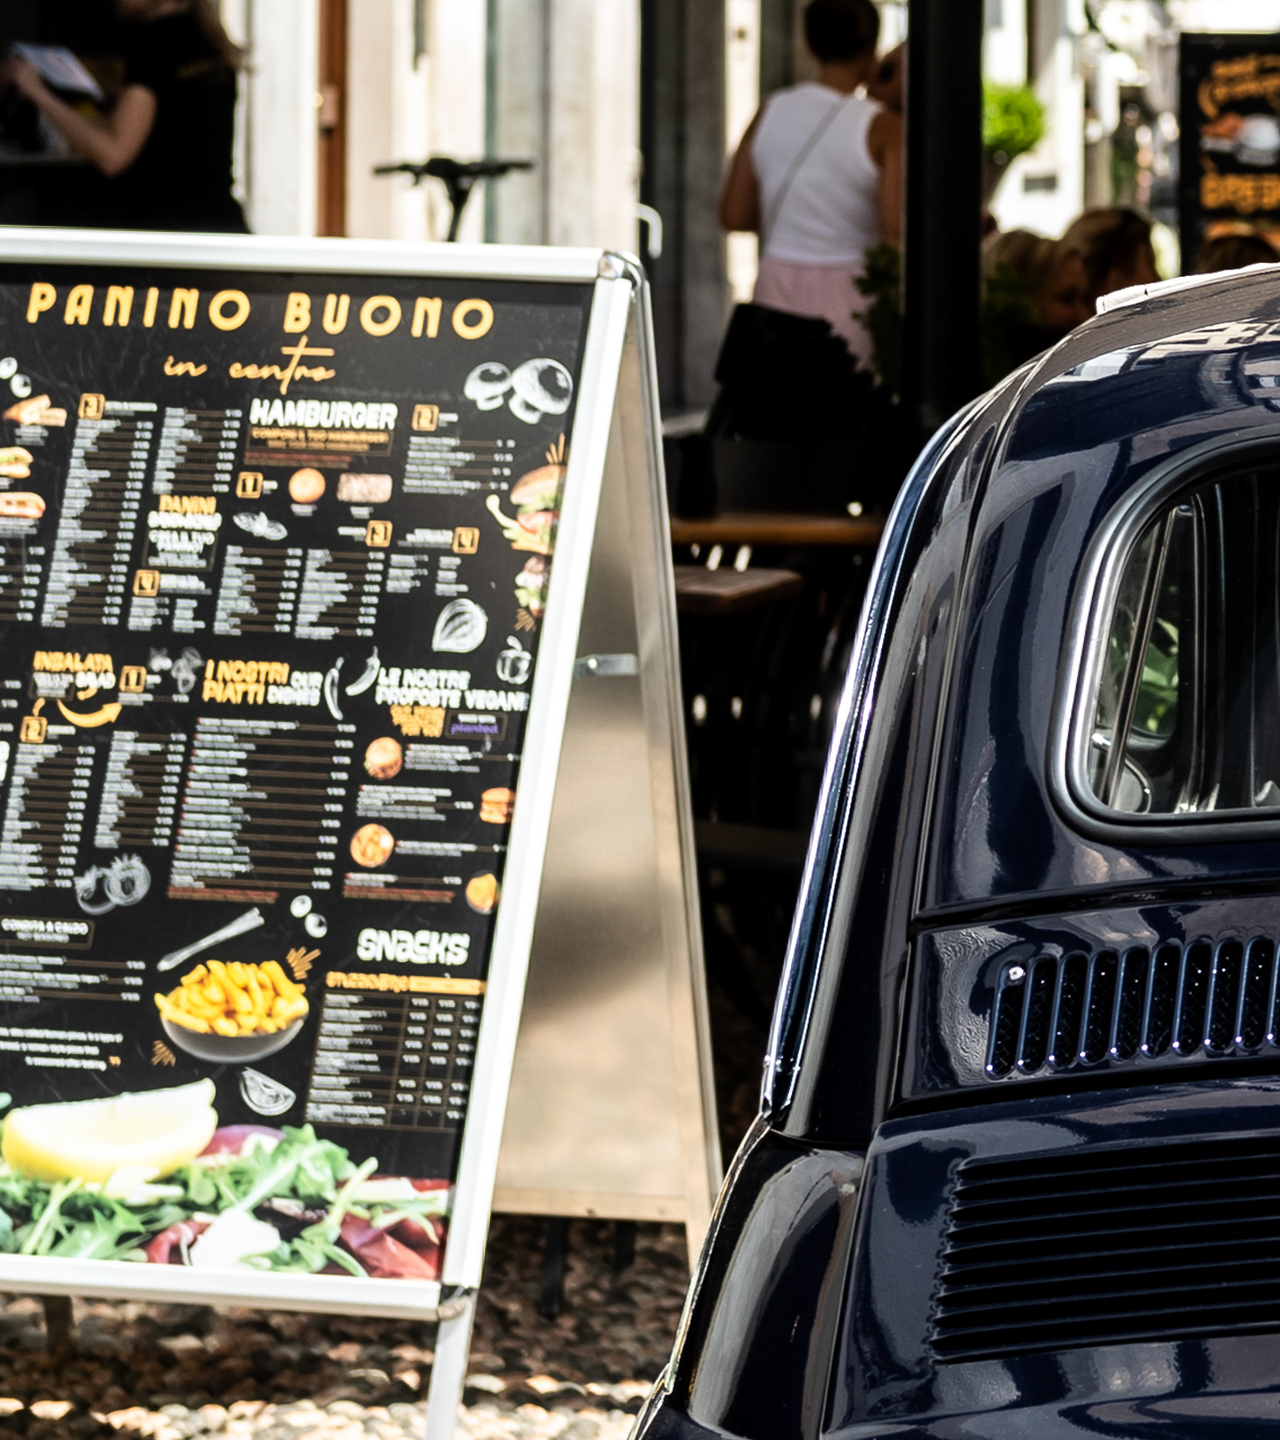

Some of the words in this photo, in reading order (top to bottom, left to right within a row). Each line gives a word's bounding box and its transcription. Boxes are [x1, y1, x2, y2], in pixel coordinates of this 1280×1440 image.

[26, 282, 250, 331] PANINO
[283, 292, 494, 340] BUONO
[163, 355, 207, 376] in
[229, 335, 335, 395] centro
[250, 398, 398, 430] HAMBURGER
[217, 660, 289, 684] NOSTRI
[378, 667, 401, 687] LE
[202, 680, 265, 705] PIATTI
